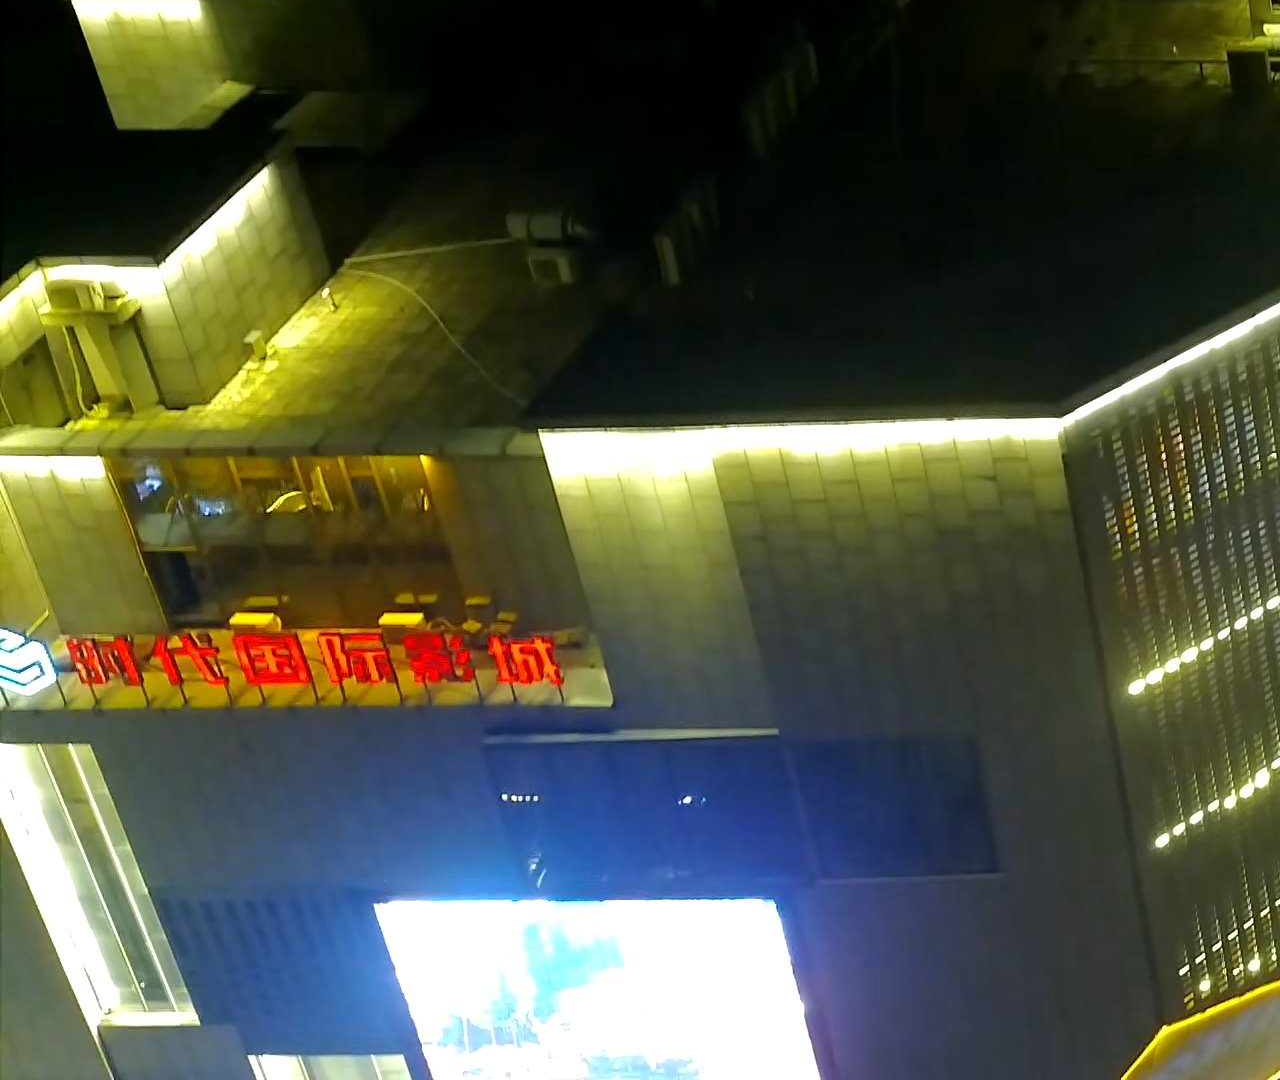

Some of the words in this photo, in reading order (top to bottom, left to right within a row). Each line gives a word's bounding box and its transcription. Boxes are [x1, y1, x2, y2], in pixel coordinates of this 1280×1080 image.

[67, 631, 565, 687] 时代国际影城
